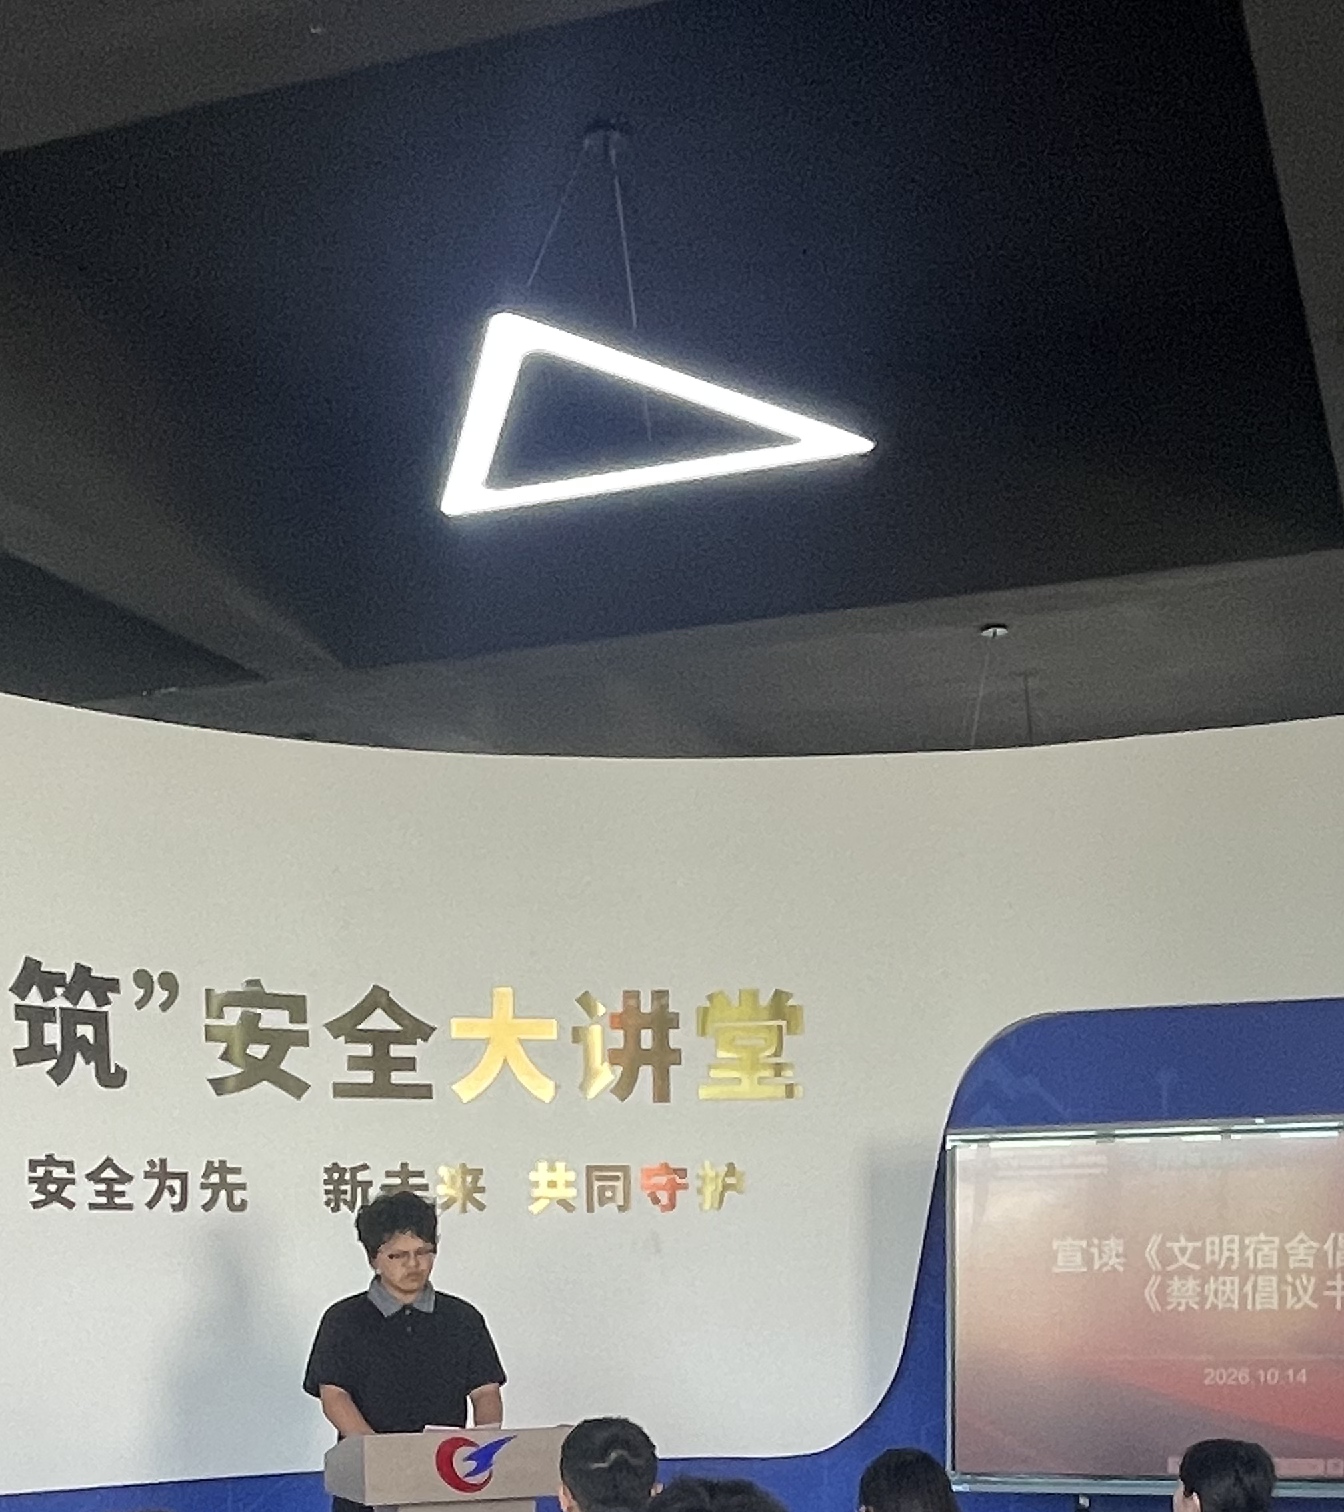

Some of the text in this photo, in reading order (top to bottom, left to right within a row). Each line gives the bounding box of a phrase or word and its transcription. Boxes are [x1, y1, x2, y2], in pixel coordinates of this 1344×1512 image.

[27, 1152, 248, 1213] 安全为先
[528, 1161, 747, 1214] 共同守护
[1203, 1367, 1308, 1386] 2026.10.14
